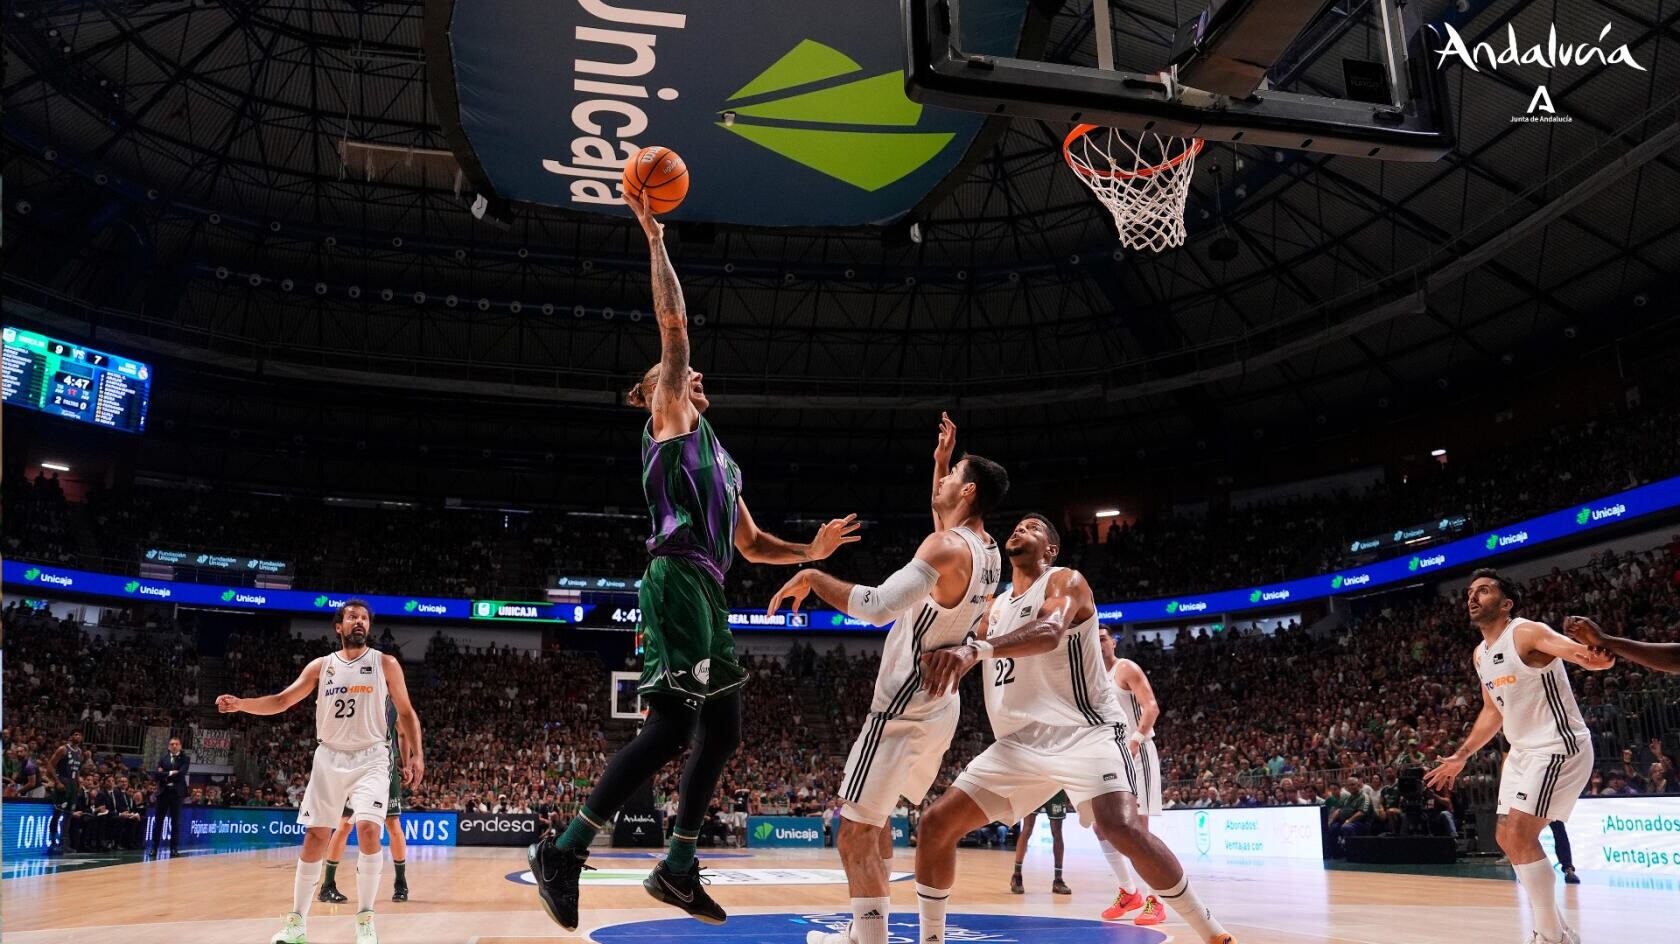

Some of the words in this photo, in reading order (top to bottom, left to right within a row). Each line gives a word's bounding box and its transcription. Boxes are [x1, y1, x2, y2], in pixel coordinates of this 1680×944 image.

[55, 345, 64, 355] 9
[72, 348, 86, 360] VS
[94, 355, 102, 365] 7
[64, 375, 90, 390] 4:47
[55, 396, 62, 405] 2
[1592, 503, 1626, 520] Unicaja
[1499, 530, 1528, 546] Unicaja
[1420, 554, 1446, 568] Unicaja
[40, 573, 73, 586] Unicaja
[1343, 574, 1370, 587] Unicaja
[140, 585, 171, 598] Unicaja
[1262, 589, 1290, 601] Unicaja
[236, 594, 266, 606] Unicaja
[1179, 601, 1207, 612] Unicaja
[418, 604, 447, 614] Unicaja
[498, 606, 538, 618] UNICAJA
[574, 605, 584, 622] 9
[750, 614, 785, 625] MADRID
[995, 657, 1015, 687] 22
[334, 699, 356, 719] 23
[459, 816, 535, 833] endesa
[775, 828, 820, 842] Unicaja
[1603, 846, 1669, 868] Ventajas
